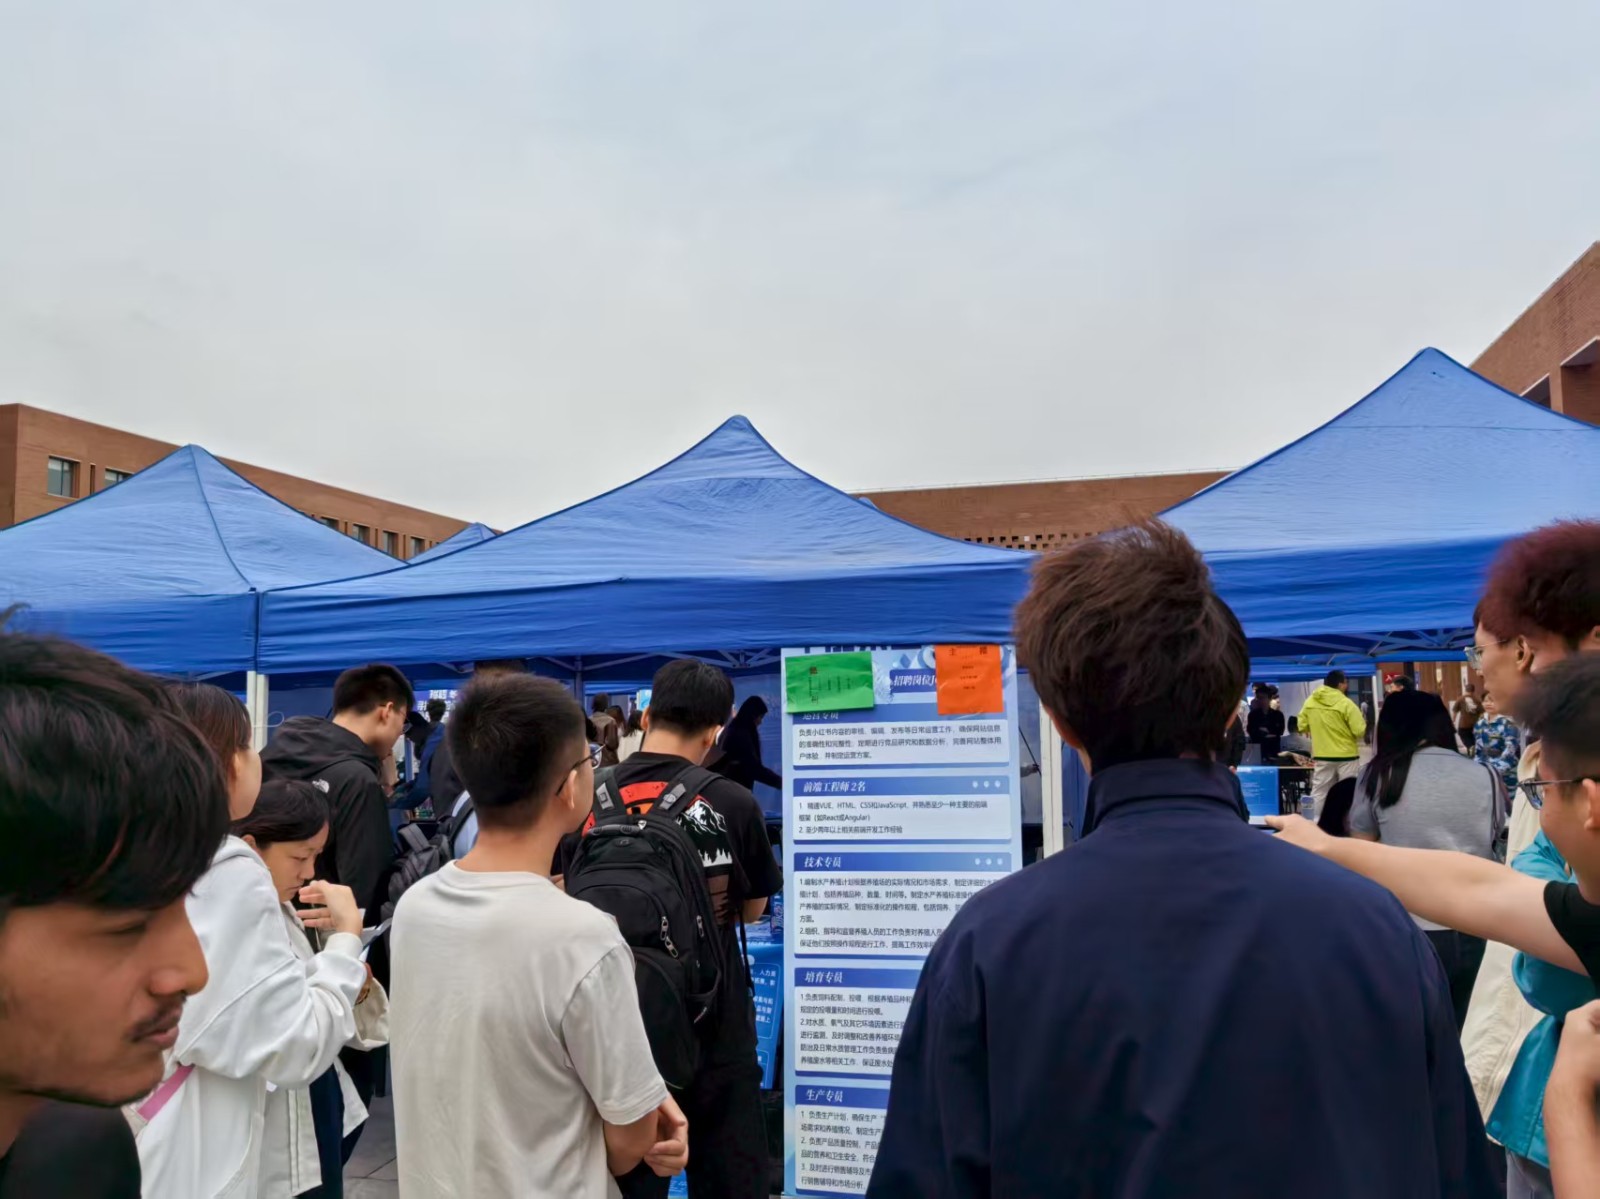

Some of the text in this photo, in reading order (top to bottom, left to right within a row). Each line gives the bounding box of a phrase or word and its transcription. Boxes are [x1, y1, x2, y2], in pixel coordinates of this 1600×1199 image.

[893, 674, 937, 687] 招聘岗位J
[804, 856, 841, 868] 技术专员
[804, 971, 843, 983] 培育专员
[805, 1089, 844, 1103] 生产专员
